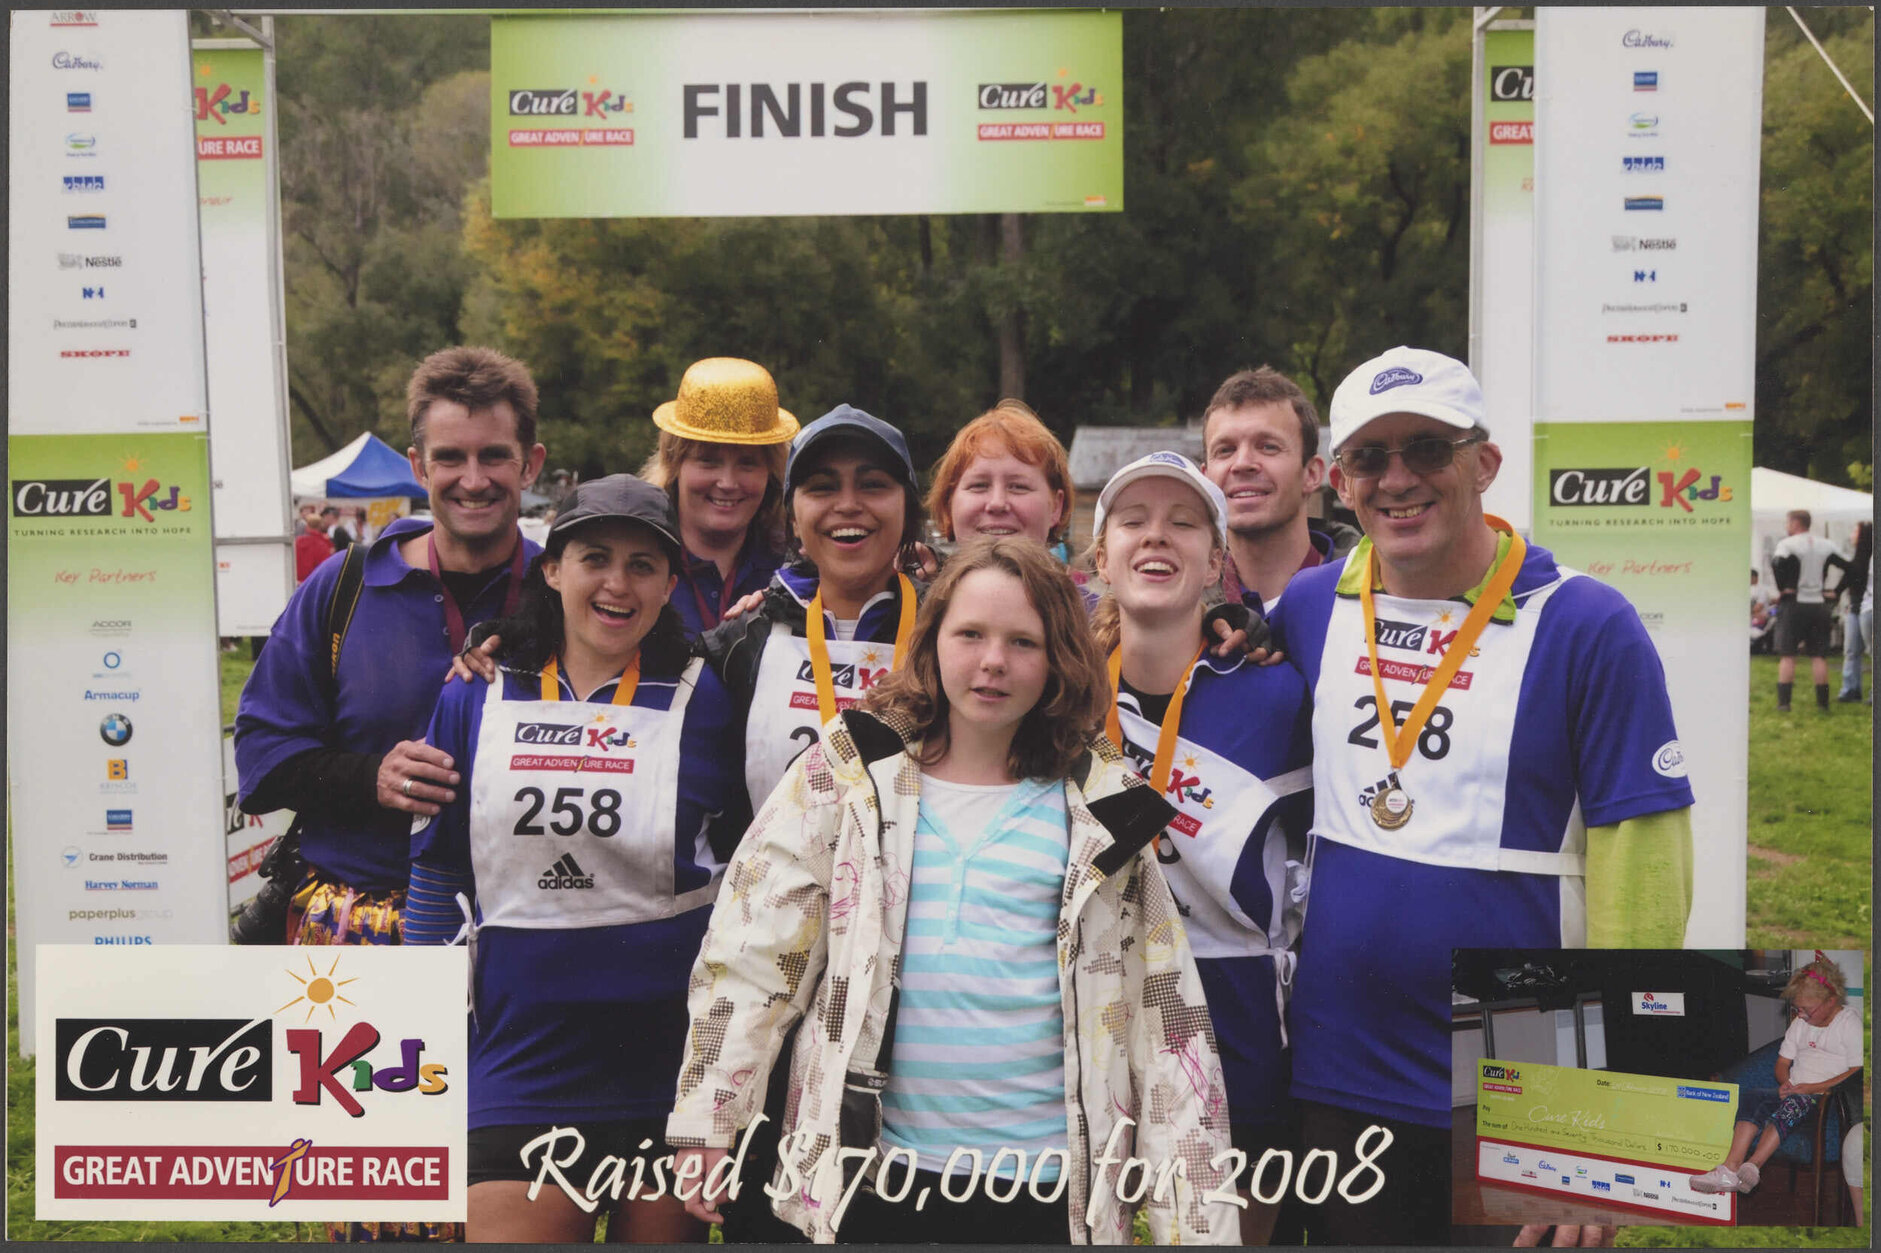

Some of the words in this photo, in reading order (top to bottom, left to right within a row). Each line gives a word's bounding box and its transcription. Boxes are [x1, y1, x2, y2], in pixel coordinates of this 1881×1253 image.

[195, 83, 259, 125] Kids
[511, 88, 576, 115] Cure
[582, 90, 632, 120] Kids
[980, 82, 1046, 109] Cure
[1052, 83, 1104, 113] Kids
[683, 80, 928, 139] FINISH
[511, 132, 543, 144] GREAT
[605, 131, 632, 143] RACE
[980, 126, 1012, 138] GREAT
[1075, 124, 1102, 136] RACE
[226, 140, 259, 155] RACE
[1553, 467, 1649, 504] Cure
[1657, 467, 1732, 513] Kids
[17, 478, 110, 514] Cure
[118, 478, 192, 523] Kids
[1550, 519, 1600, 527] TURNING
[1606, 518, 1664, 526] RESEARCH
[1669, 517, 1696, 525] INTO
[1701, 517, 1731, 525] HOPE
[15, 529, 65, 538] TURNING
[70, 528, 127, 537] RESEARCH
[132, 527, 158, 536] INTO
[163, 526, 192, 535] HOPE
[1587, 560, 1613, 576] Key
[1622, 559, 1693, 575] Partners
[55, 571, 80, 585] Key
[89, 568, 158, 583] Partners
[85, 690, 140, 702] Armacup
[518, 723, 585, 745] Cure
[587, 727, 638, 751] Kids
[513, 757, 543, 768] GREAT
[605, 760, 630, 771] RACE
[1167, 768, 1214, 810] Kids
[513, 786, 623, 838] 258
[1174, 814, 1197, 832] RACE
[89, 853, 115, 862] Crane
[117, 852, 168, 862] Distribution
[85, 880, 119, 890] Harvey
[121, 880, 159, 890] Norman
[538, 876, 594, 890] adidas
[1641, 1001, 1668, 1011] Skyline
[1657, 1143, 1662, 1151] $
